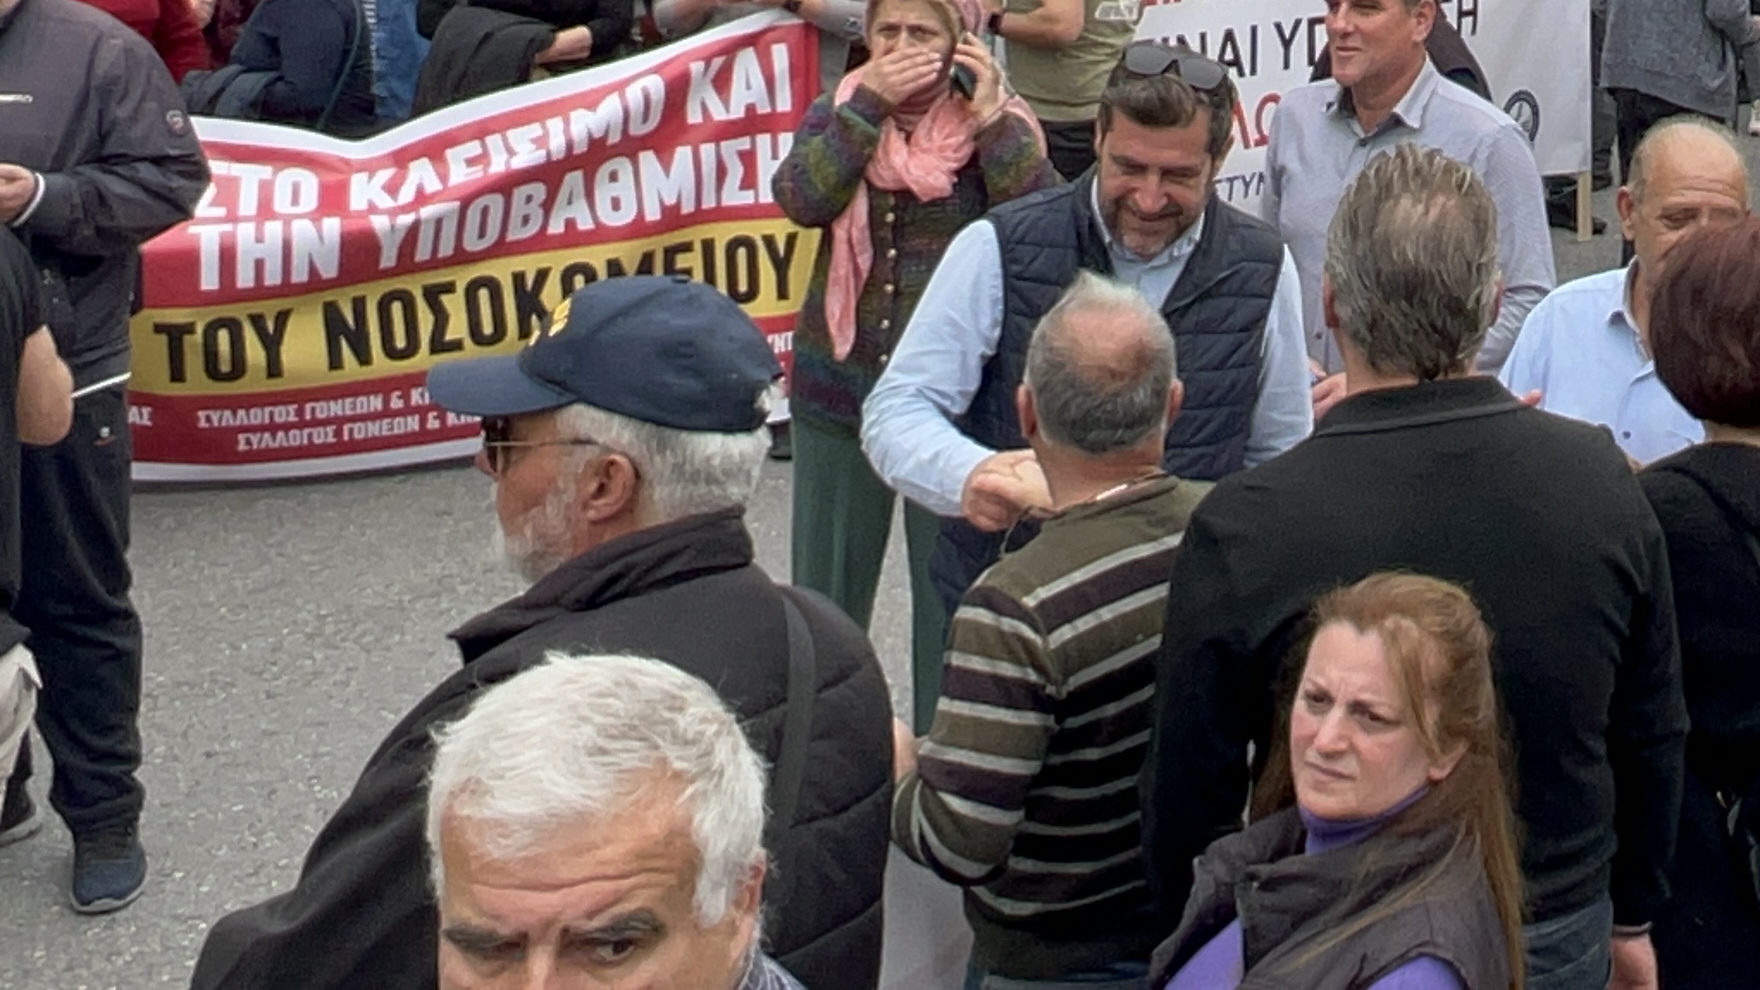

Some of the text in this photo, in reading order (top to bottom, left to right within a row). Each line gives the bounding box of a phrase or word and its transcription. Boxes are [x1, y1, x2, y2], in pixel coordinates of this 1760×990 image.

[349, 73, 666, 211] ΚΛΕΙΣΙΜΟ
[686, 43, 792, 124] ΚΑΙ
[188, 131, 796, 291] ΤΗΝ ΥΠΟΒΑΘΜΙΣΗ
[153, 308, 294, 383] ΤΟΥ
[197, 406, 300, 428] ΣΥΛΛΟΓΟΣ
[304, 396, 384, 421] ΓΟΝΕΩΝ
[390, 390, 405, 409] &
[237, 428, 337, 452] ΣΥΛΛΟΓΟΣ
[343, 414, 420, 441] ΓΟΝΕΩΝ
[426, 411, 441, 430] &
